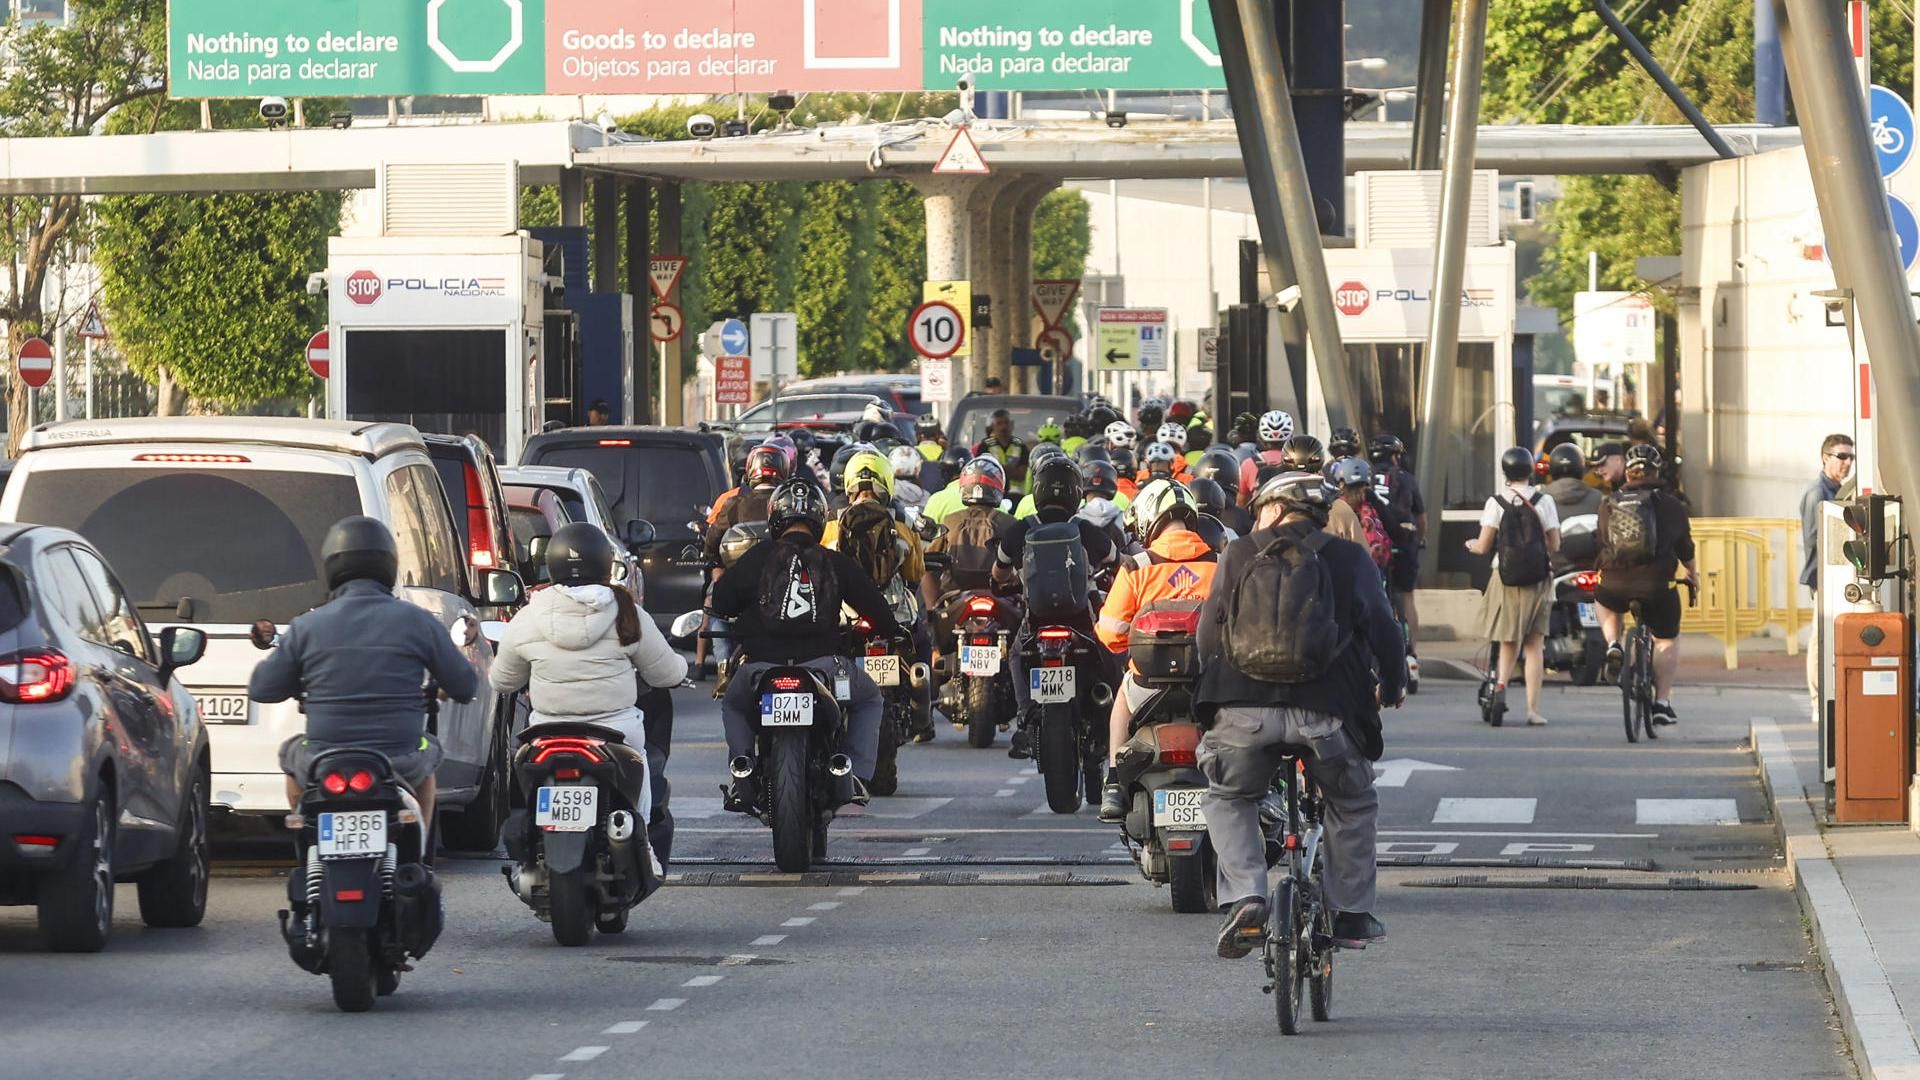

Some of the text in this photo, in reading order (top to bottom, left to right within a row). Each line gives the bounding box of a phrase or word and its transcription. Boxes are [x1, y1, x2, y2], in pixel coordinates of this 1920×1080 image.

[187, 31, 398, 58] Nothing to declare
[562, 28, 755, 50] Goods to declare
[939, 24, 1152, 51] Nothing to declare
[187, 58, 378, 85] Nada para declarar
[562, 55, 778, 82] Objetos para declarar
[939, 52, 1132, 78] Nada para declarar
[650, 262, 677, 271] GIVE
[348, 278, 380, 296] STOP
[387, 278, 481, 290] POLICIA
[1037, 285, 1066, 296] GIVE
[1337, 289, 1369, 307] STOP
[1376, 289, 1469, 301] POLIA
[921, 316, 954, 343] 10
[723, 360, 744, 368] NEW
[721, 370, 745, 379] ROAD
[717, 381, 748, 390] LAYOUT
[718, 392, 747, 401] AHEAD
[47, 428, 112, 440] WESTFALIA
[970, 649, 997, 660] 0636
[866, 658, 896, 672] 5662
[970, 659, 990, 669] NBV
[1041, 669, 1073, 683] 2718
[1041, 683, 1065, 696] MMK
[196, 697, 244, 716] 1102
[774, 696, 810, 710] 0713
[773, 710, 801, 723] BMM
[552, 790, 592, 806] 4598
[552, 806, 581, 821] MBD
[1173, 807, 1201, 823] GSF
[335, 814, 382, 832] 3366
[335, 832, 370, 851] HFR
[1376, 841, 1595, 856] OP
